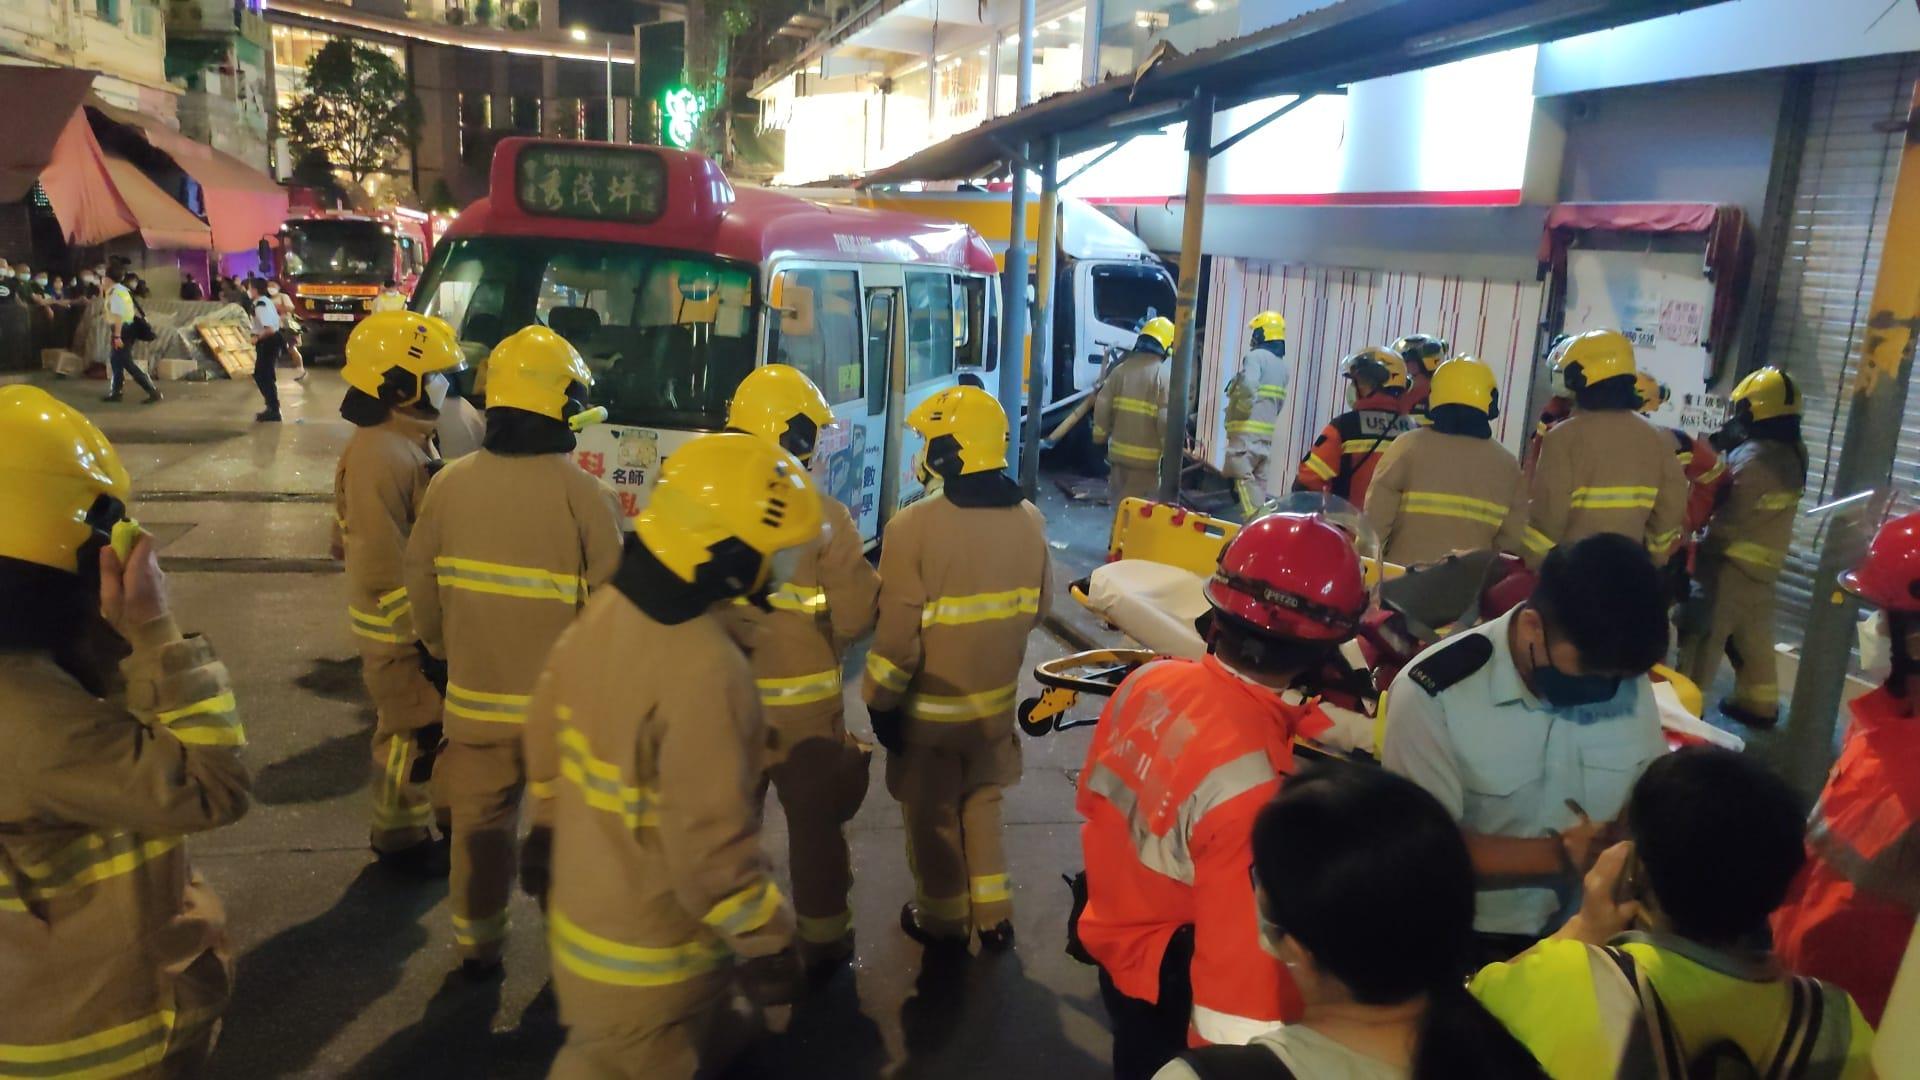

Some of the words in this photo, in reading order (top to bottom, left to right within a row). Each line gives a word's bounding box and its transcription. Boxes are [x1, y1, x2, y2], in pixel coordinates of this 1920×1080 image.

[538, 167, 640, 216] 秀茂坪
[612, 468, 645, 486] 名師
